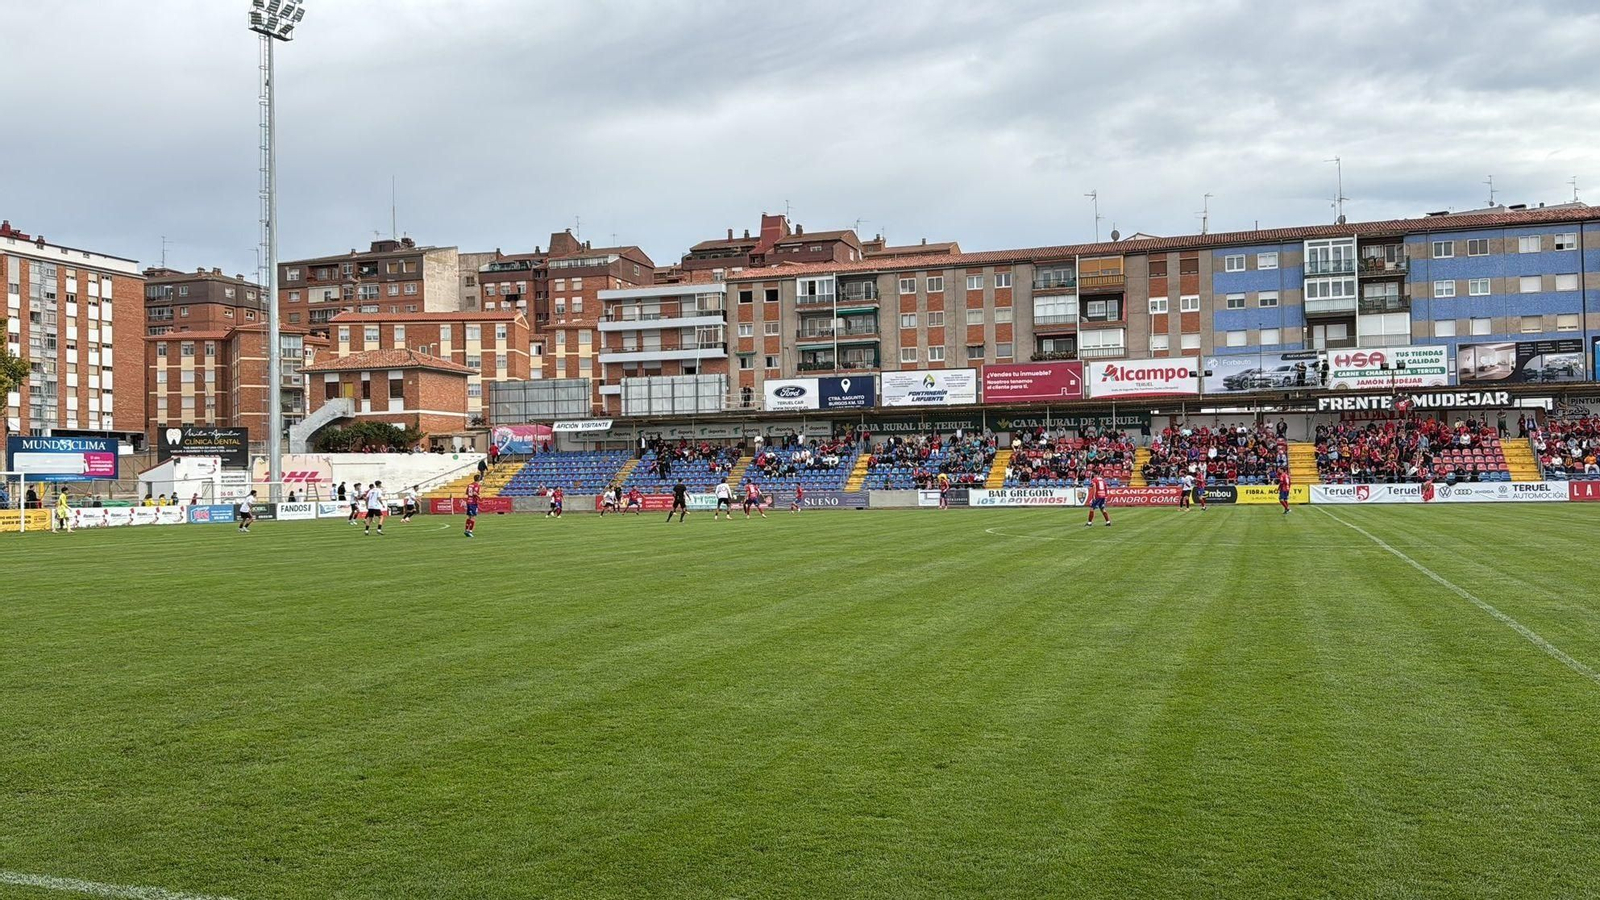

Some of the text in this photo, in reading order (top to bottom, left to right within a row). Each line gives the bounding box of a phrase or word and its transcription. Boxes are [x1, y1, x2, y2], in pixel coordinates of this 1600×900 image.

[1334, 352, 1386, 368] HSA
[1102, 364, 1188, 382] Alcampo
[1356, 378, 1384, 386] JAMÓN
[780, 387, 800, 397] Ford
[1318, 392, 1509, 411] FRENTE MUDEJAR
[856, 421, 974, 432] CAJA RURAL DE TERUEL
[1013, 416, 1142, 428] CAJA RURAL DE TERUEL
[1010, 489, 1055, 497] GREGORY
[1323, 487, 1355, 495] Teruel
[1387, 486, 1419, 495] Teruel
[1512, 491, 1568, 499] AUTOMOCIÓN
[804, 496, 839, 506] SUEÑO
